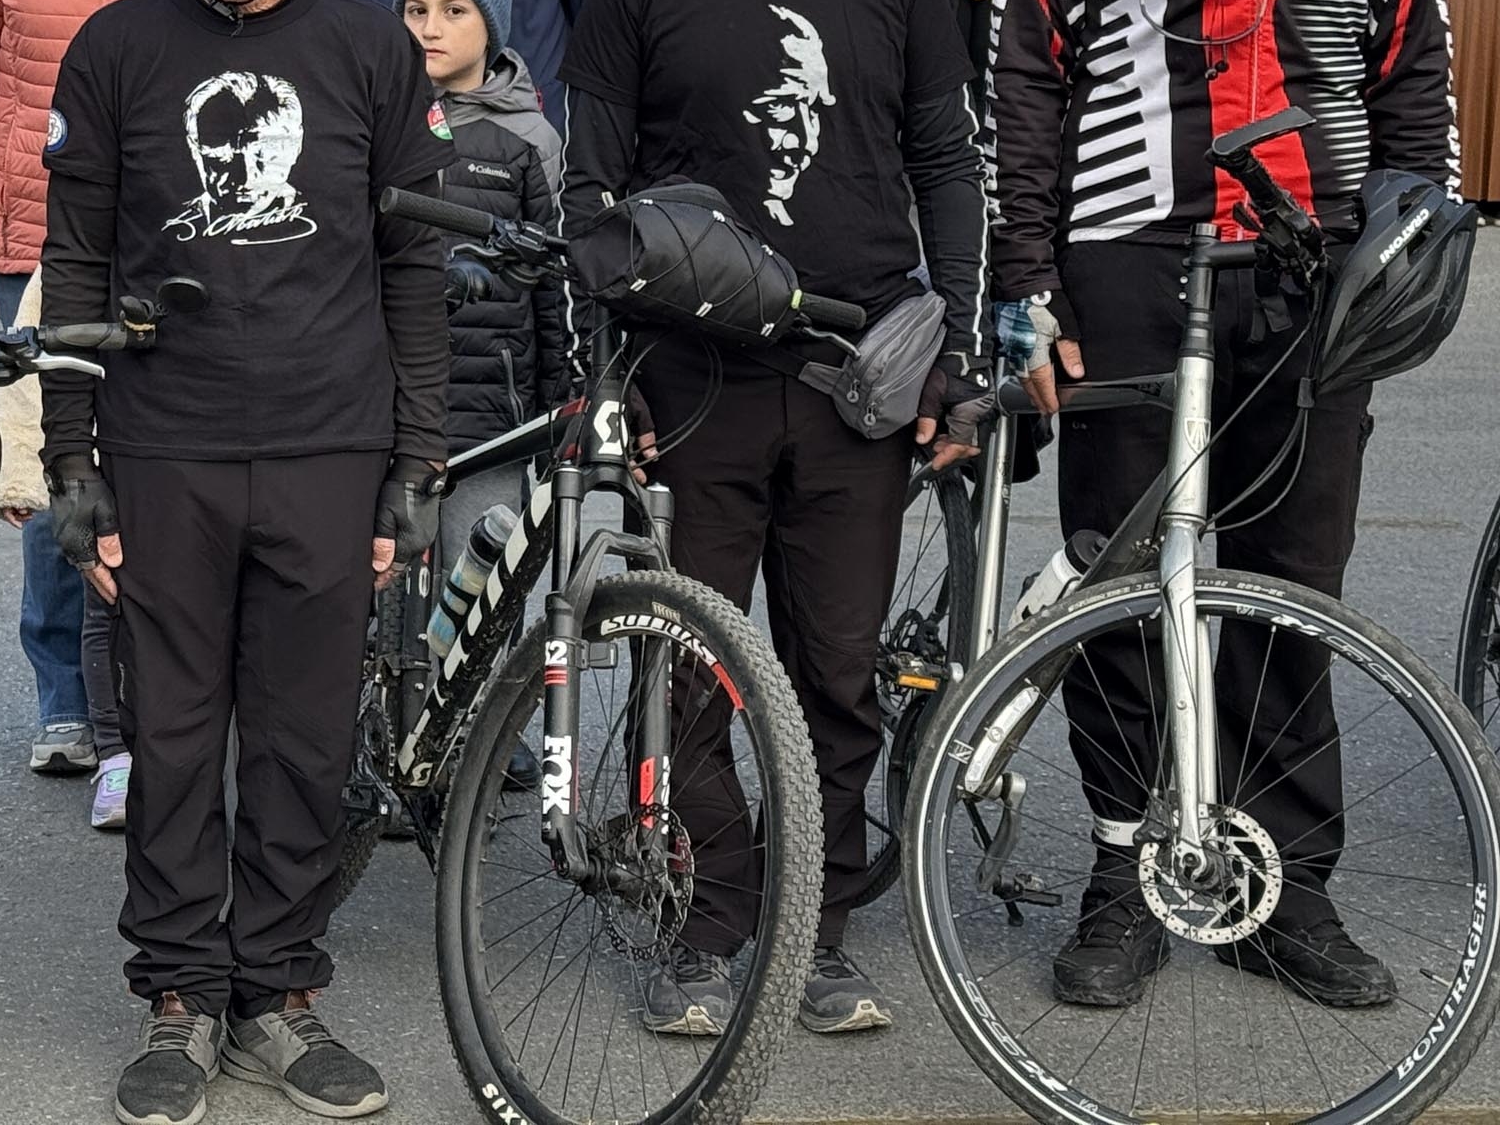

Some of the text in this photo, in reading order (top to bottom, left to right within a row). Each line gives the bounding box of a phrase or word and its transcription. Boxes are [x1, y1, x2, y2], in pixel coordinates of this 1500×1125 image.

[475, 165, 511, 180] Columbia
[1379, 208, 1430, 264] CRATONI
[542, 735, 573, 815] FOX
[1396, 884, 1488, 1081] BONTRAGER
